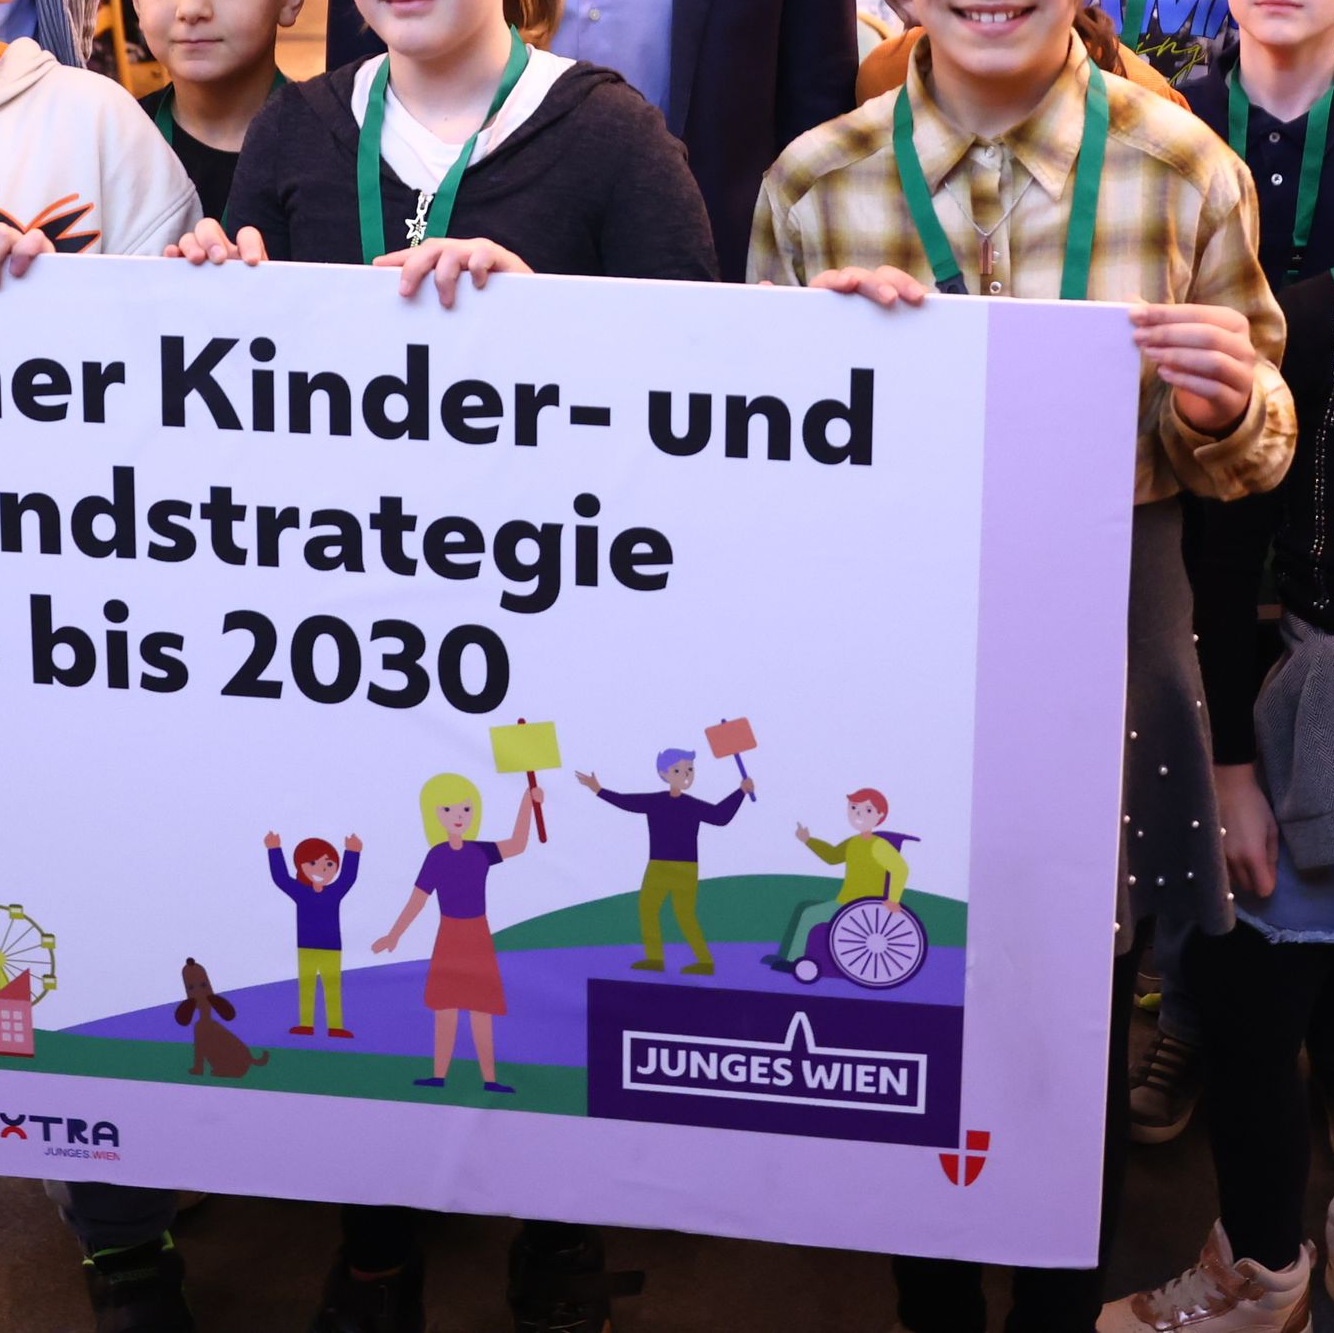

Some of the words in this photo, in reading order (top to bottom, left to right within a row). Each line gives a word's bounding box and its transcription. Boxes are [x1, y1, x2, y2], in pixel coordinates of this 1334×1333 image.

[160, 335, 611, 447] Kinder-
[648, 368, 875, 466] und
[30, 593, 189, 693] bis
[220, 609, 510, 715] 2030
[636, 1047, 793, 1087] JUNGES
[801, 1060, 908, 1096] WIEN
